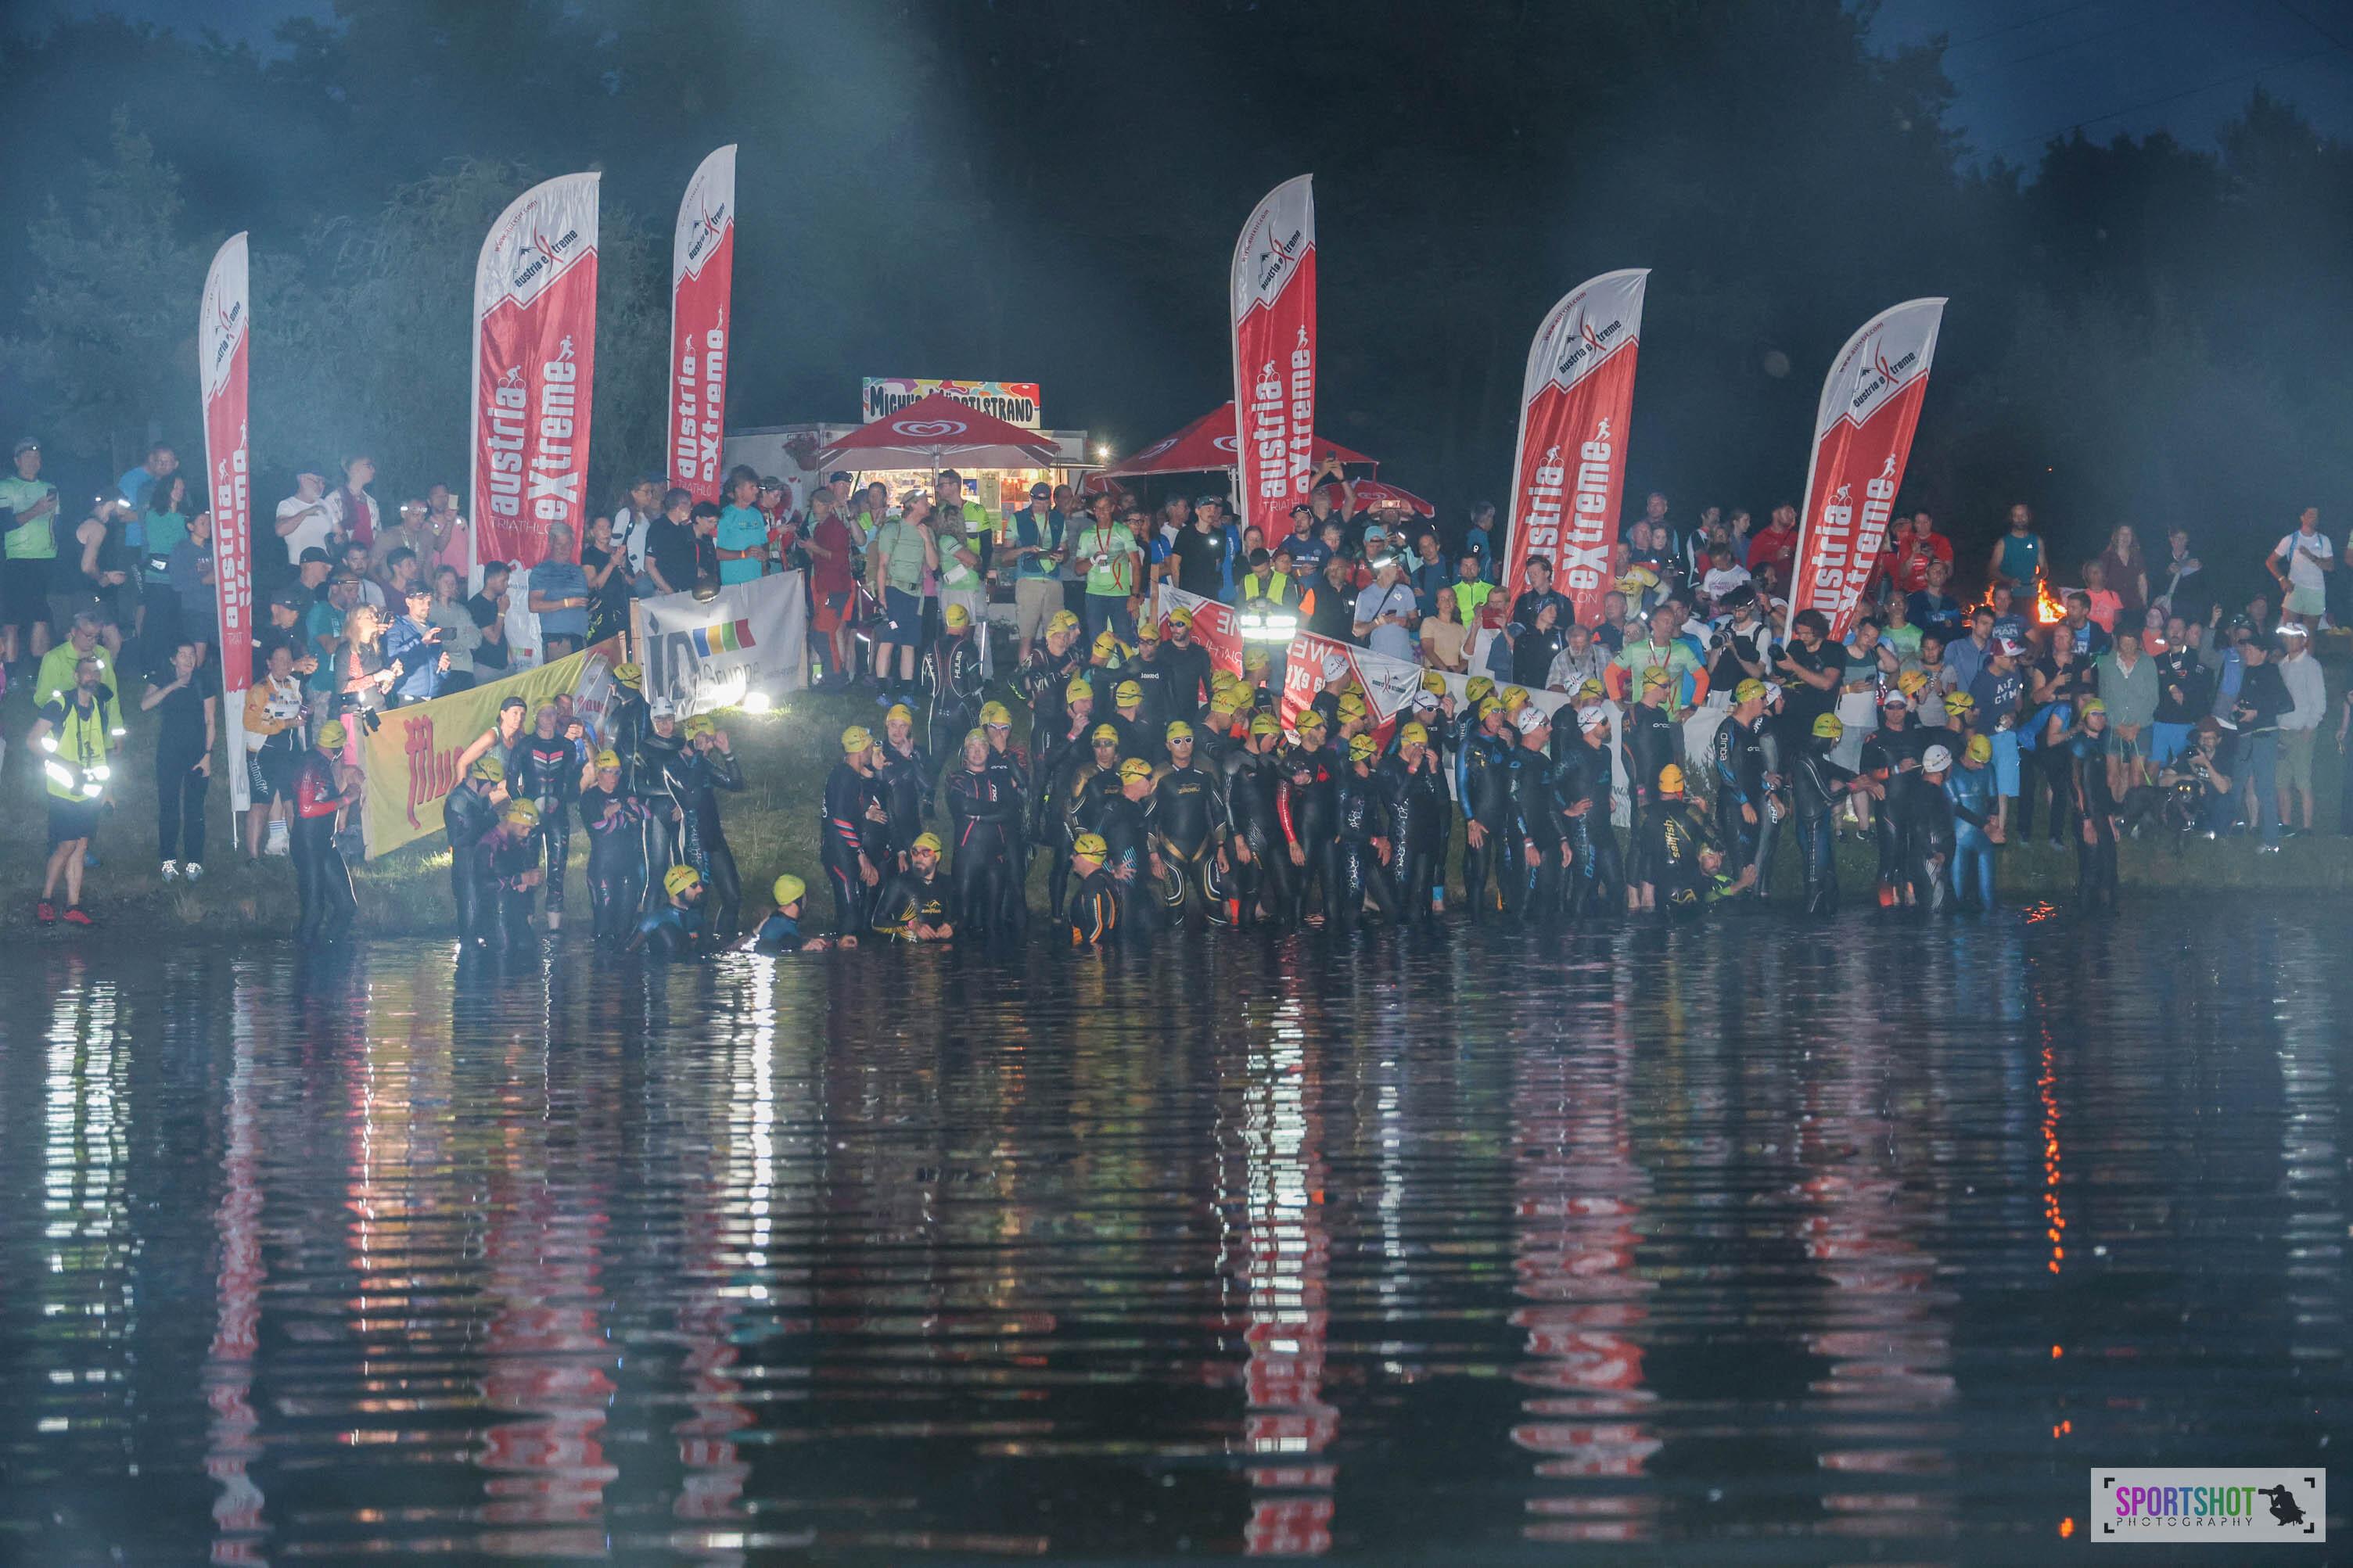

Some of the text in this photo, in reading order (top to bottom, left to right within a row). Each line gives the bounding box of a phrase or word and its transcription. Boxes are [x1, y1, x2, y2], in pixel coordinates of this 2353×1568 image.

[514, 260, 543, 288] austria
[1261, 261, 1281, 291] austria
[677, 356, 698, 479] austria
[1559, 349, 1586, 374] austria
[1852, 381, 1880, 407] austria
[487, 387, 526, 517] austria
[527, 361, 579, 520] eXtreme
[1252, 381, 1287, 498] austria
[1289, 349, 1311, 494] eXtreme
[217, 485, 239, 629] austria
[488, 515, 551, 535] TRIATHL
[1525, 465, 1564, 585] ustria
[1562, 441, 1611, 590] eXtreme
[1664, 819, 1681, 859] sailfish
